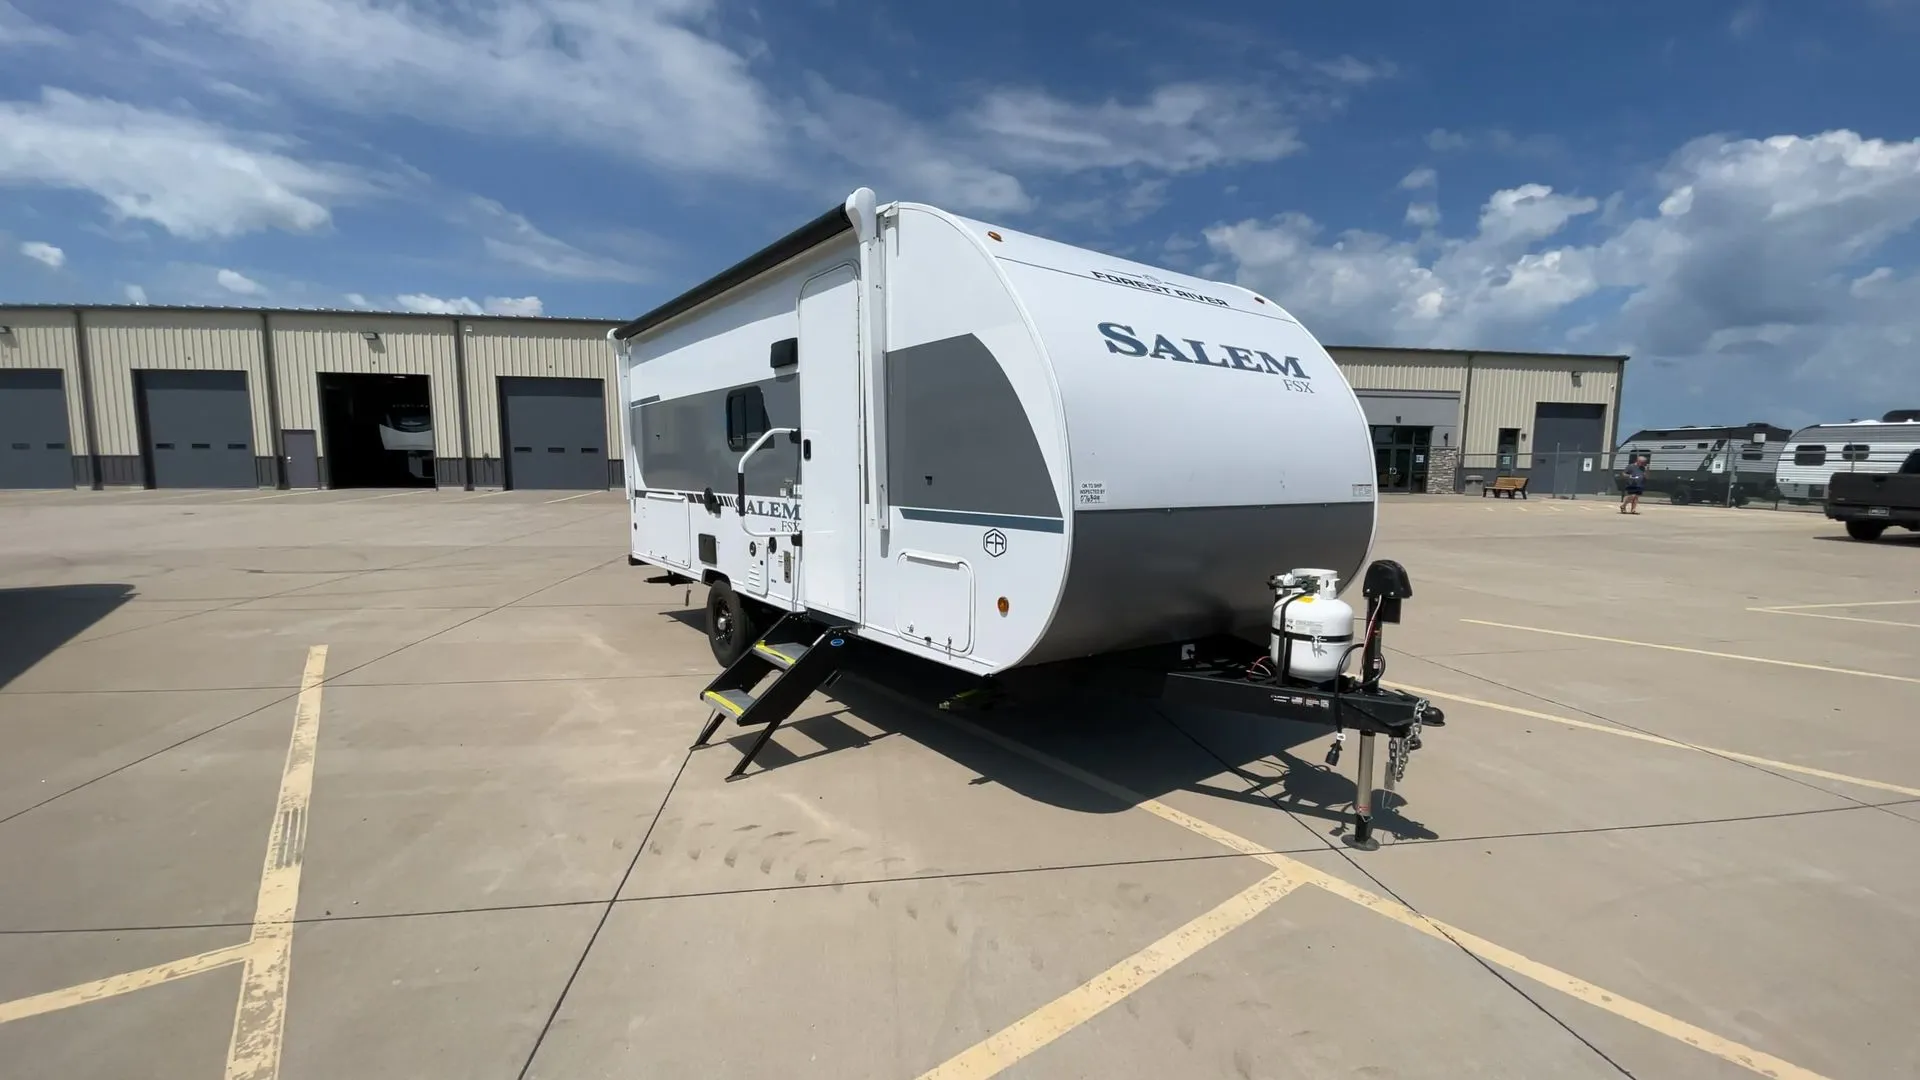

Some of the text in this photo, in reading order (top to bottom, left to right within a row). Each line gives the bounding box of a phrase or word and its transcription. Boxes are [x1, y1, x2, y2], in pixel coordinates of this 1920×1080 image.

[1091, 270, 1171, 294] FOREST
[1174, 289, 1230, 307] RIVER
[1097, 321, 1311, 380] SALEM
[1283, 379, 1315, 394] FSX
[781, 521, 800, 532] FSX
